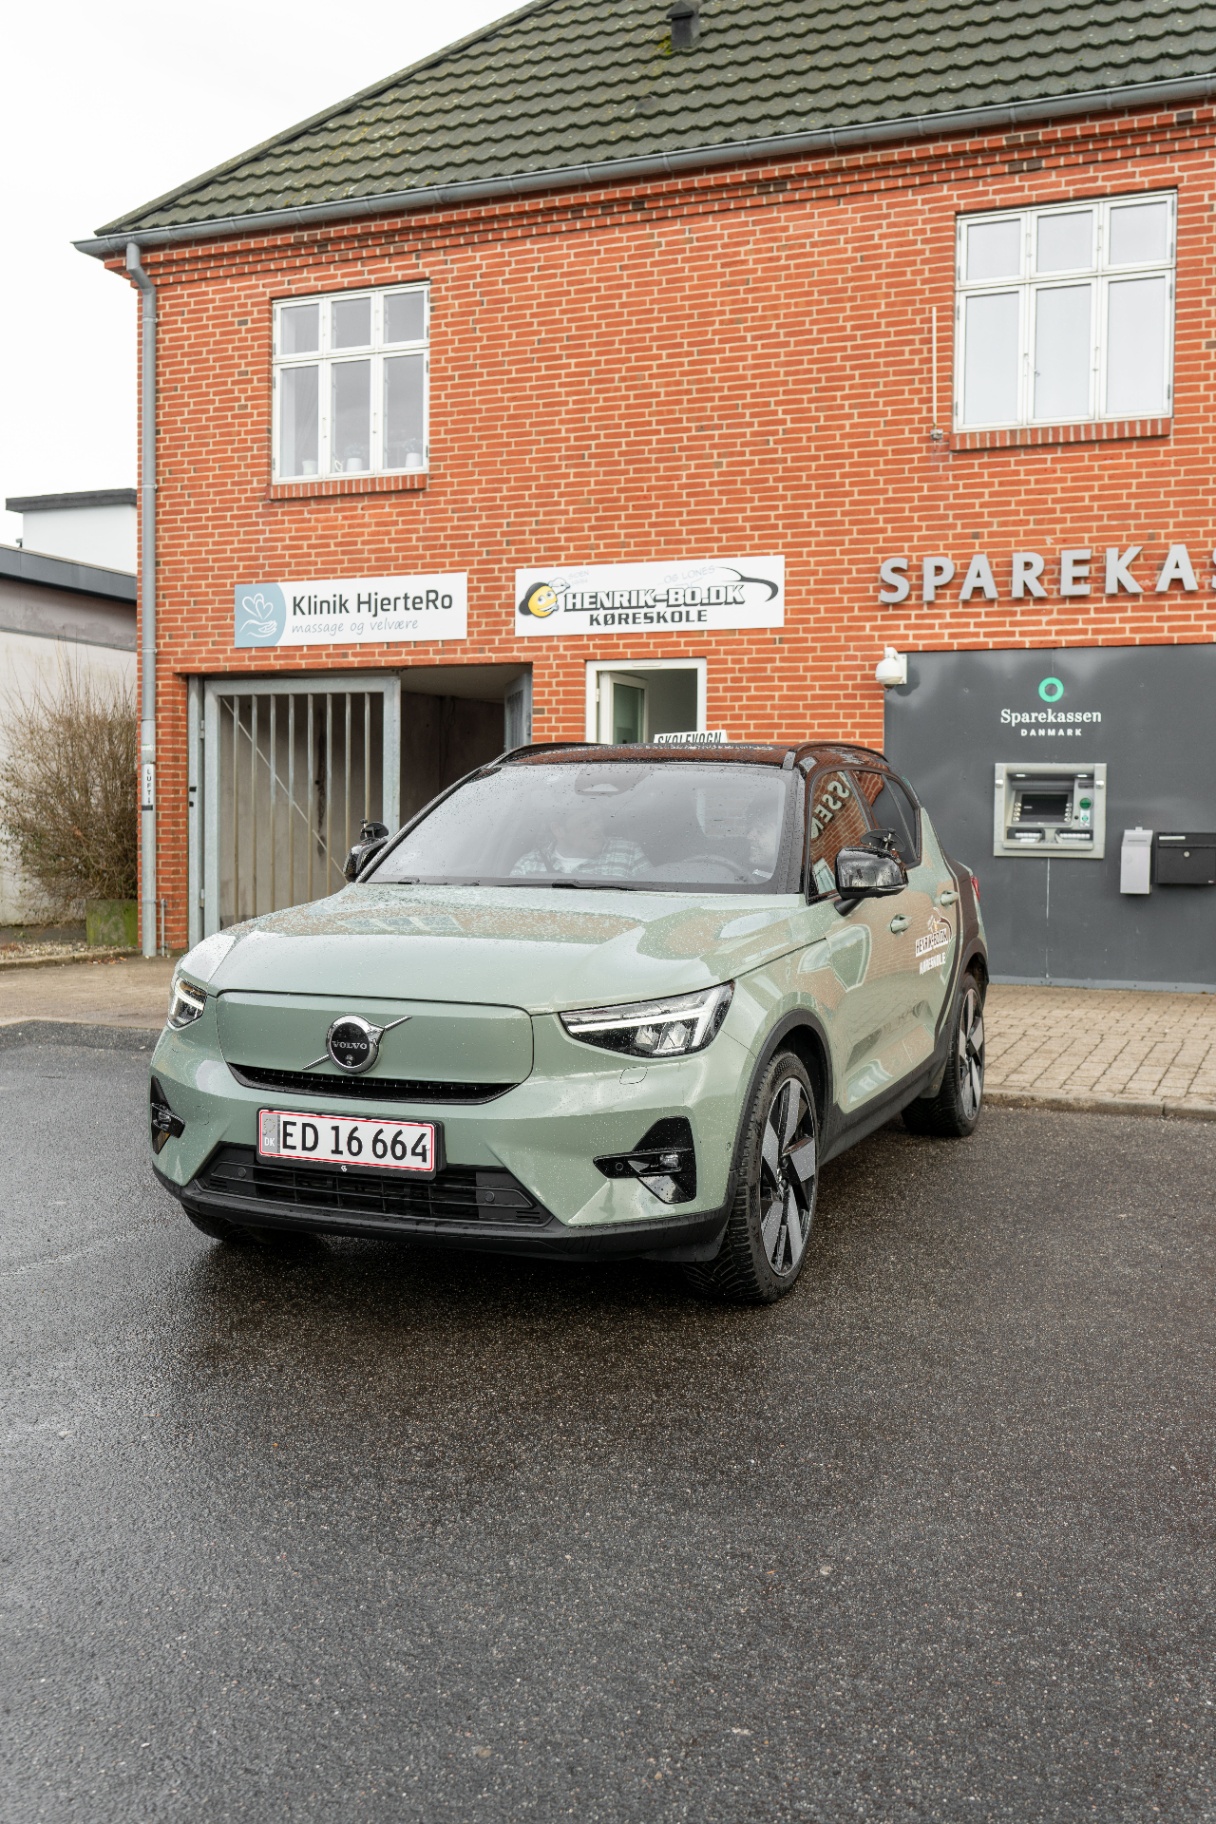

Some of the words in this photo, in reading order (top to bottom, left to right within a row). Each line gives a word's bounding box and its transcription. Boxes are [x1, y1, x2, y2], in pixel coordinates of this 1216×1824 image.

[879, 543, 1216, 604] SPAREKA
[292, 594, 350, 616] Klinik
[357, 589, 453, 617] HjerteRo
[564, 584, 745, 612] HENRIK-BO.DK
[292, 622, 344, 636] massage
[350, 622, 365, 635] og
[370, 618, 418, 631] velvære
[589, 609, 708, 627] KØRESKOLE
[1000, 709, 1101, 727] Sparekassen
[1021, 728, 1082, 736] DANMARK
[331, 1040, 368, 1050] VOLVO
[264, 1136, 276, 1147] DK
[282, 1121, 319, 1151] ED
[331, 1126, 363, 1157] 16
[371, 1128, 428, 1163] 664
